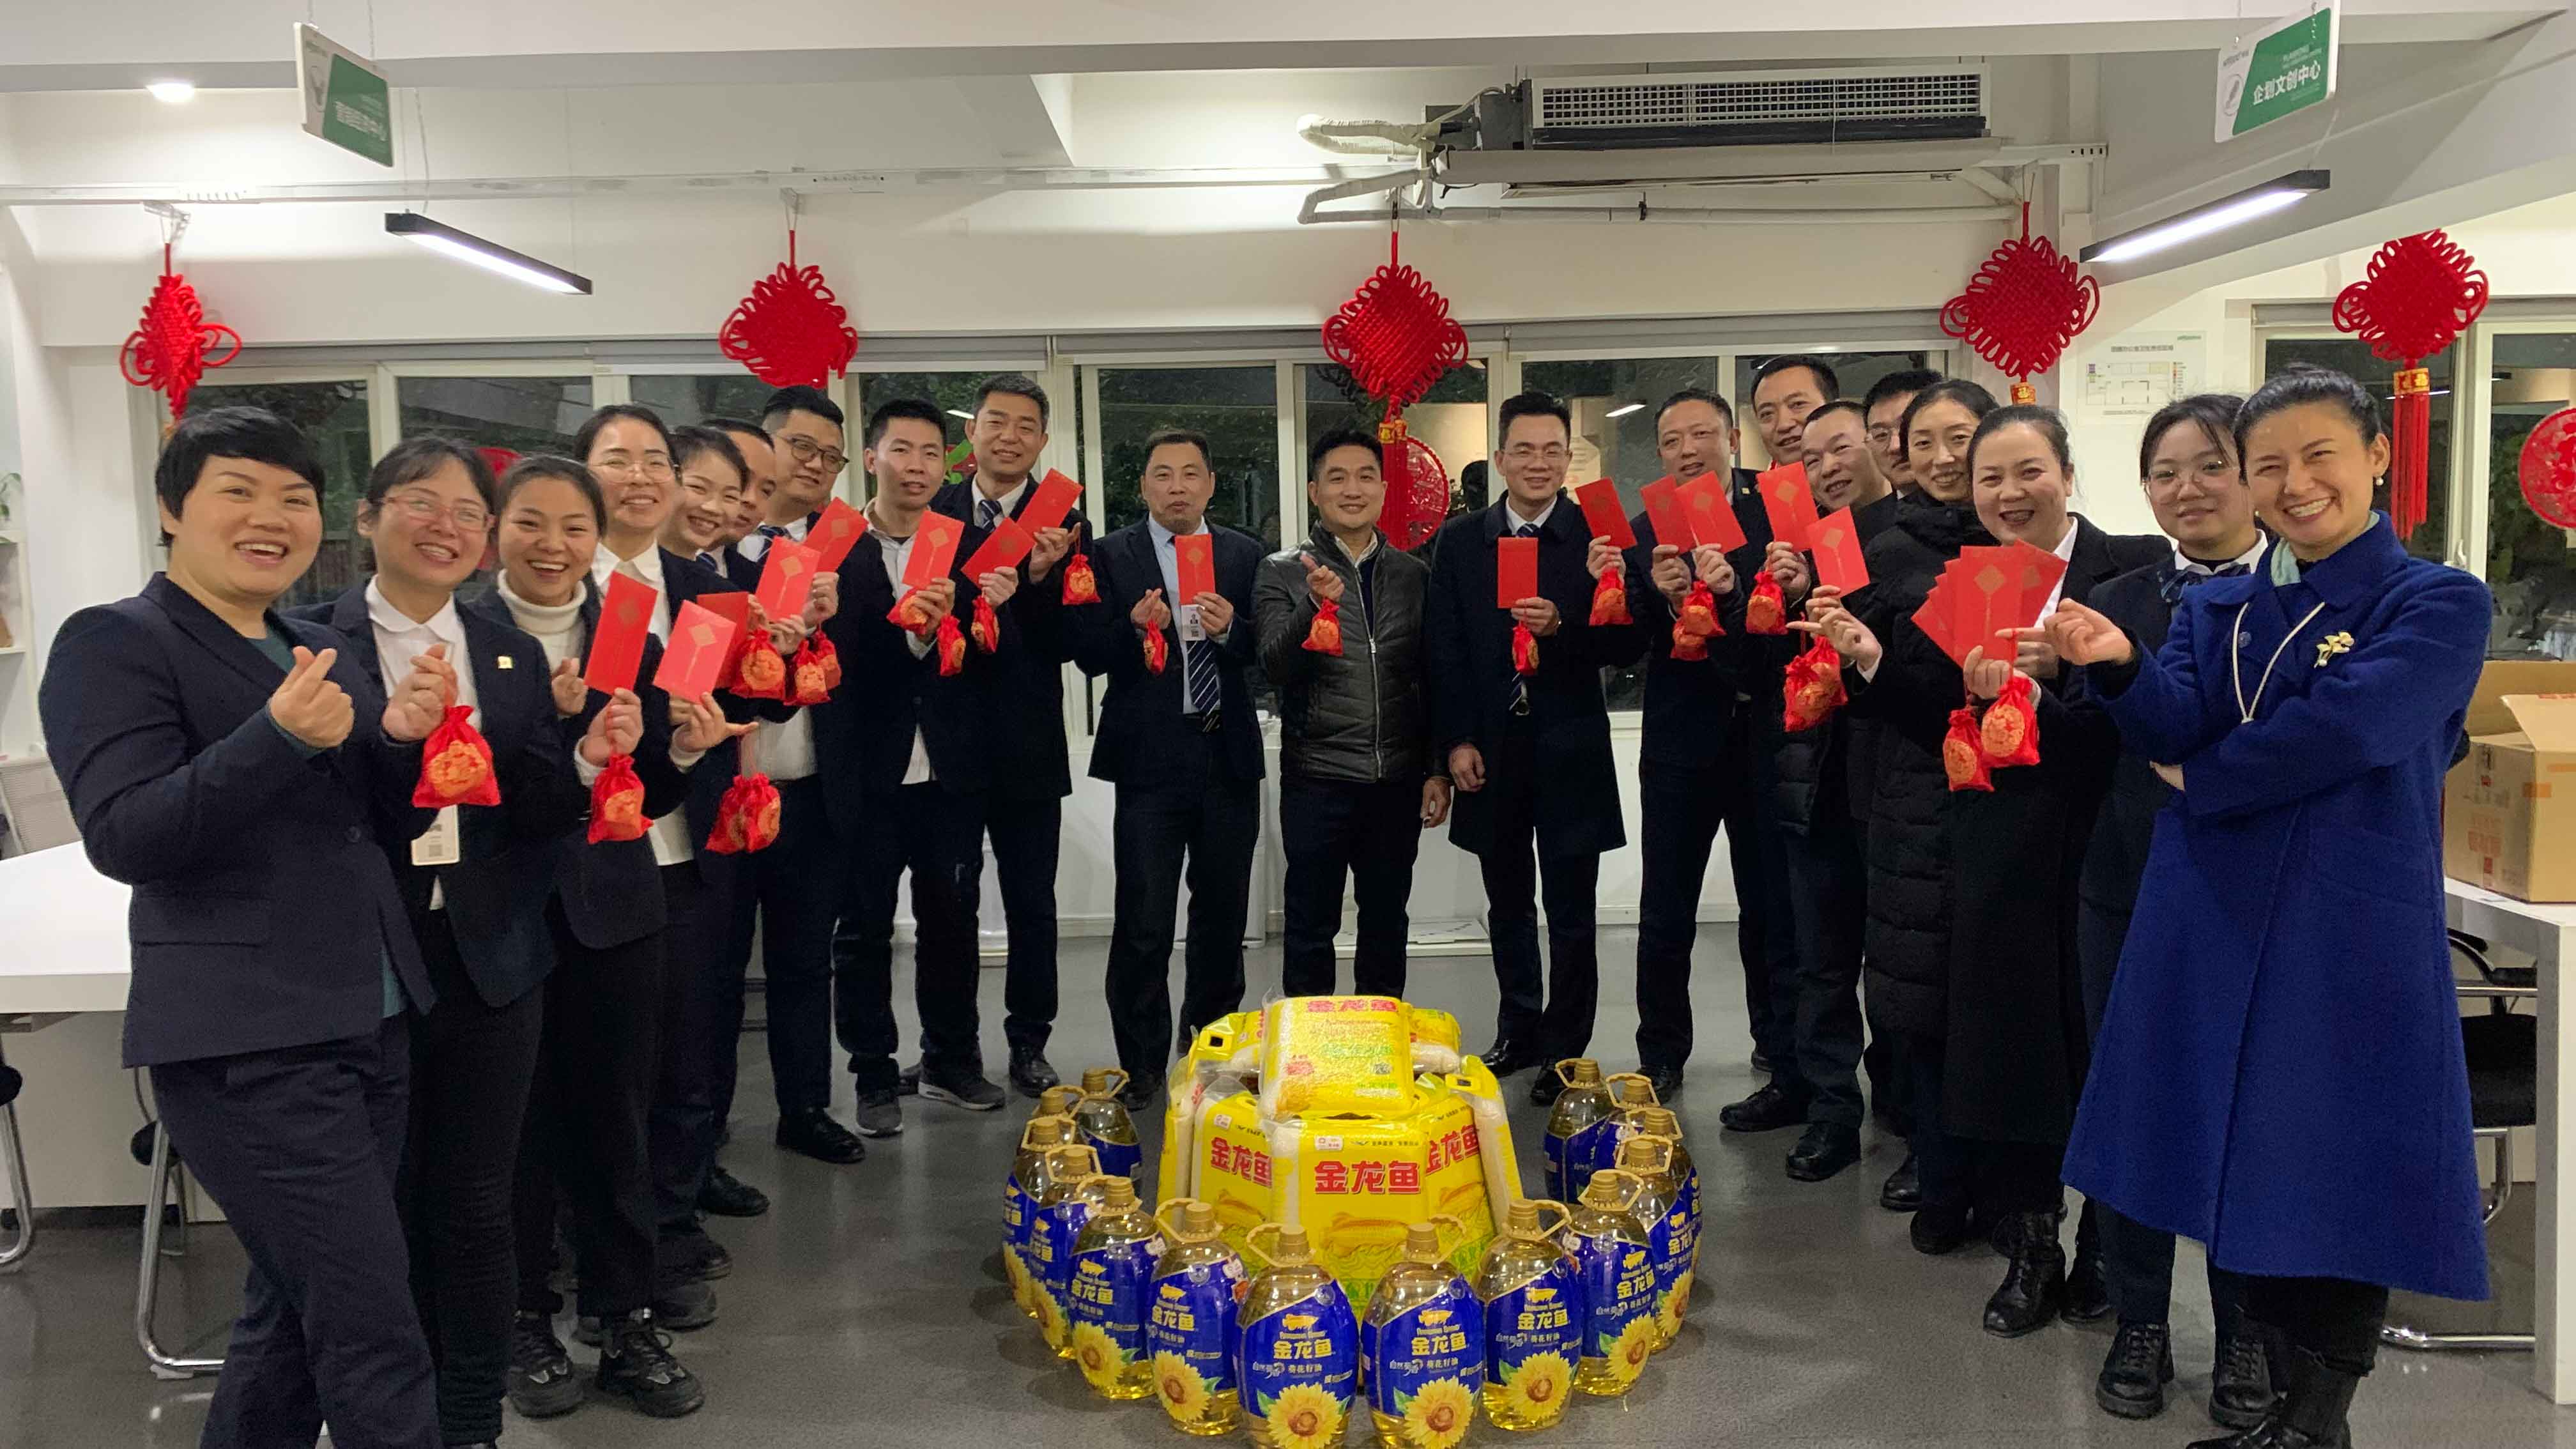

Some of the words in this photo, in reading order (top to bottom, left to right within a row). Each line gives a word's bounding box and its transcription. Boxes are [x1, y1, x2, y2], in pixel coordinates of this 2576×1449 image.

[1211, 1137, 1273, 1188] 金龙鱼
[1314, 1160, 1421, 1195] 金龙鱼
[1071, 1278, 1114, 1305] 金龙鱼
[1616, 1269, 1655, 1300] 金龙鱼
[1151, 1305, 1195, 1331] 金龙鱼
[1517, 1308, 1568, 1330] 金龙鱼
[1273, 1338, 1332, 1360] 金龙鱼
[1411, 1331, 1467, 1356] 金龙鱼
